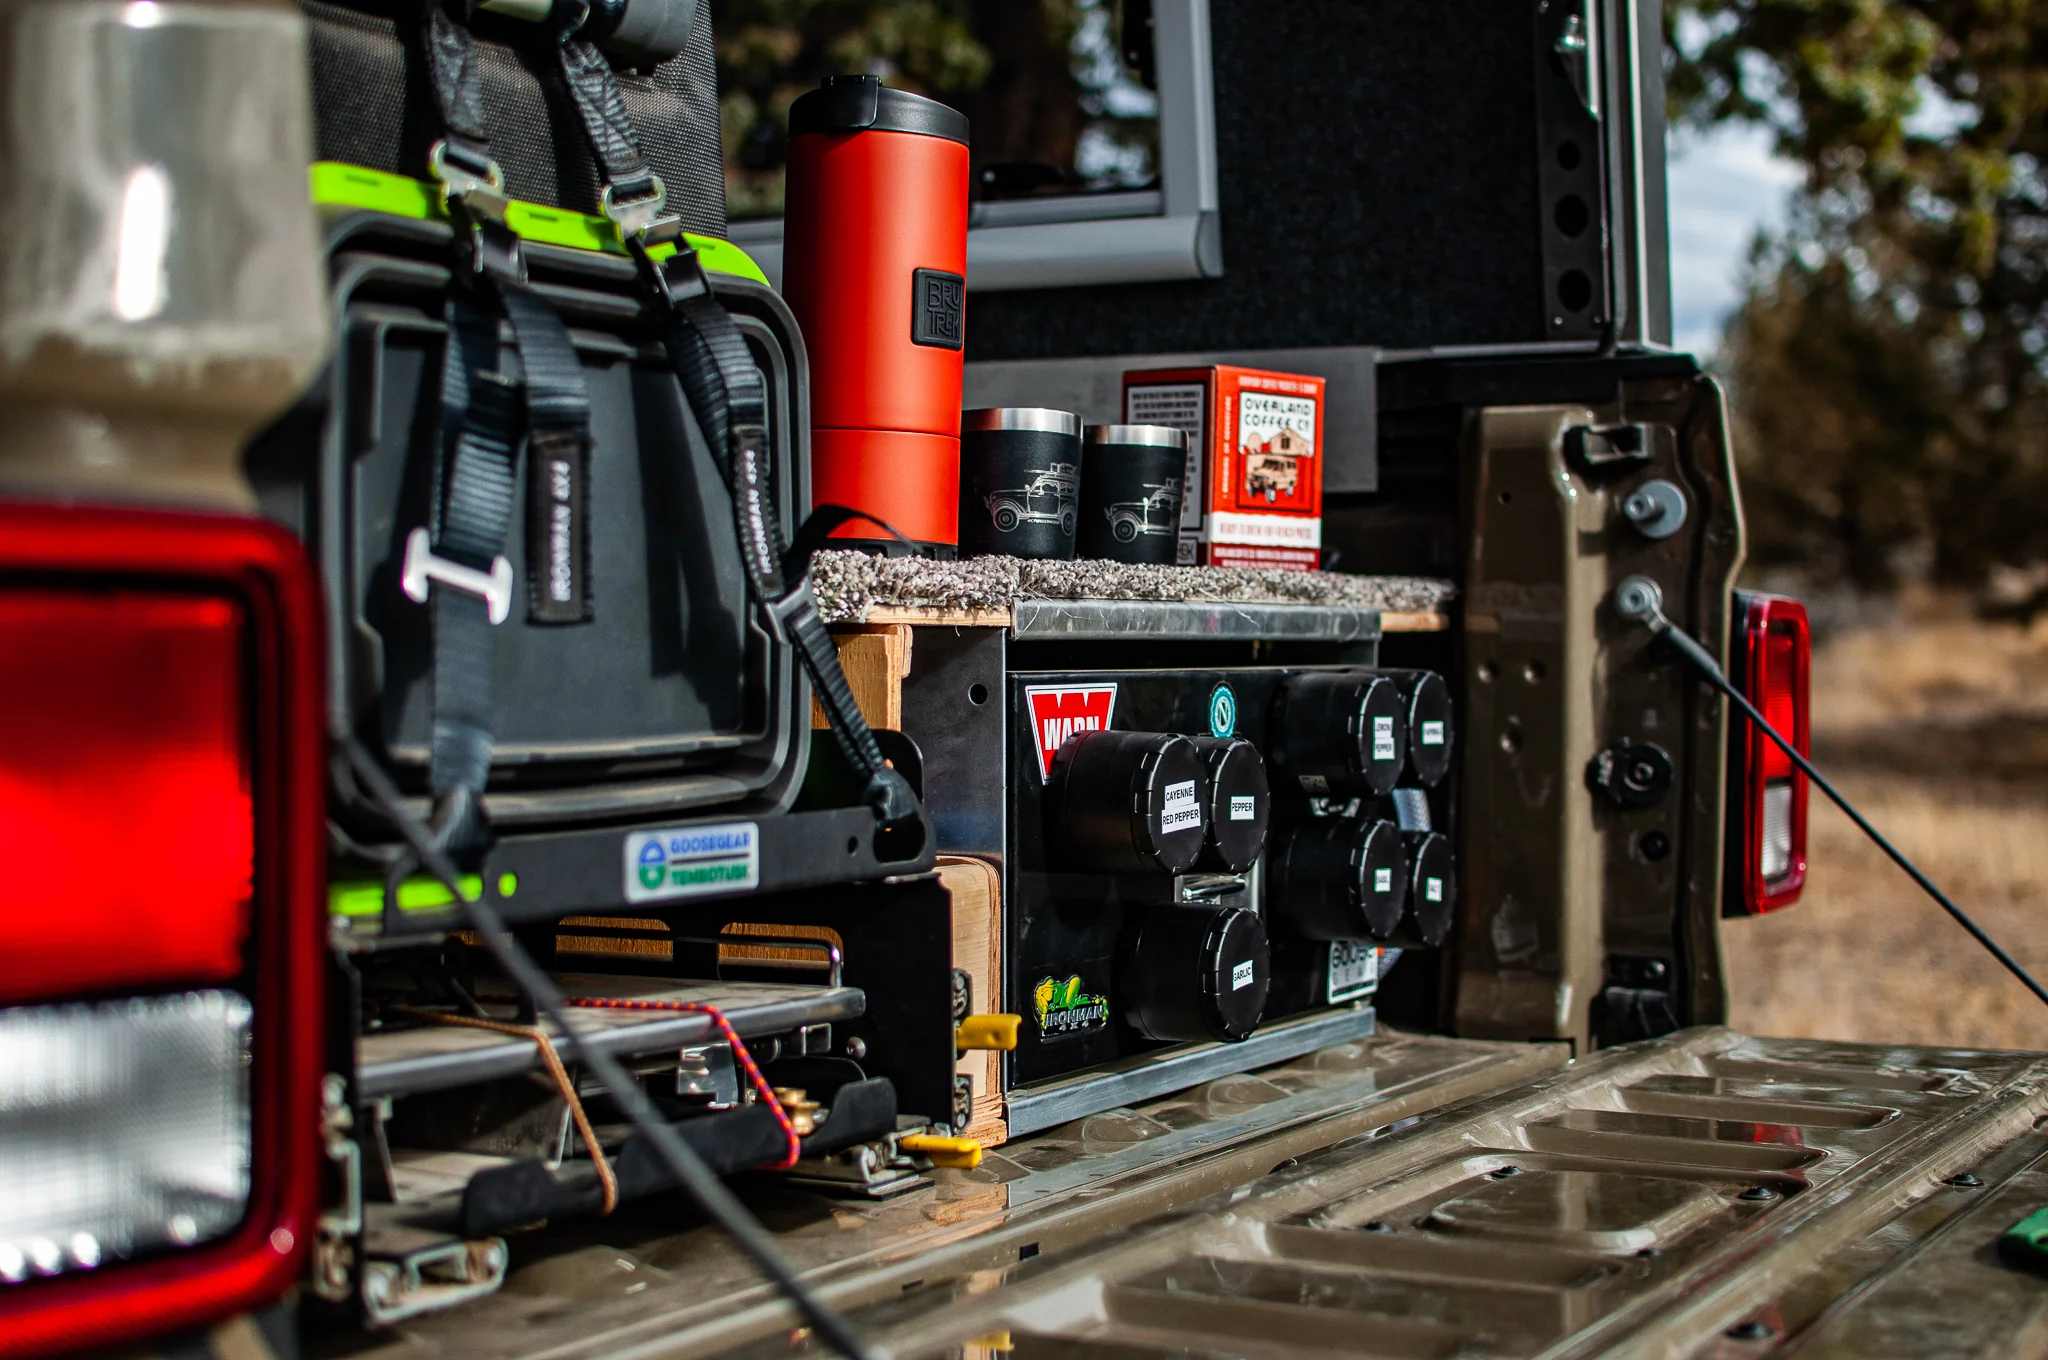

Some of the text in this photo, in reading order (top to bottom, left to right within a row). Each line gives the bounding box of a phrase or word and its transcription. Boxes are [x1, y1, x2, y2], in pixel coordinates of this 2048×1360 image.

[1245, 398, 1311, 416] OVERLAND
[1245, 414, 1292, 429] COFFEE
[748, 488, 773, 574] IRONMAN
[551, 504, 571, 601] IRONMAN
[1165, 786, 1194, 802] CAYENNE
[1232, 802, 1253, 812] PEPPER
[1162, 808, 1200, 826] RED PEPPER
[1234, 966, 1251, 982] GARLIC
[1046, 1004, 1104, 1027] IRONMAN
